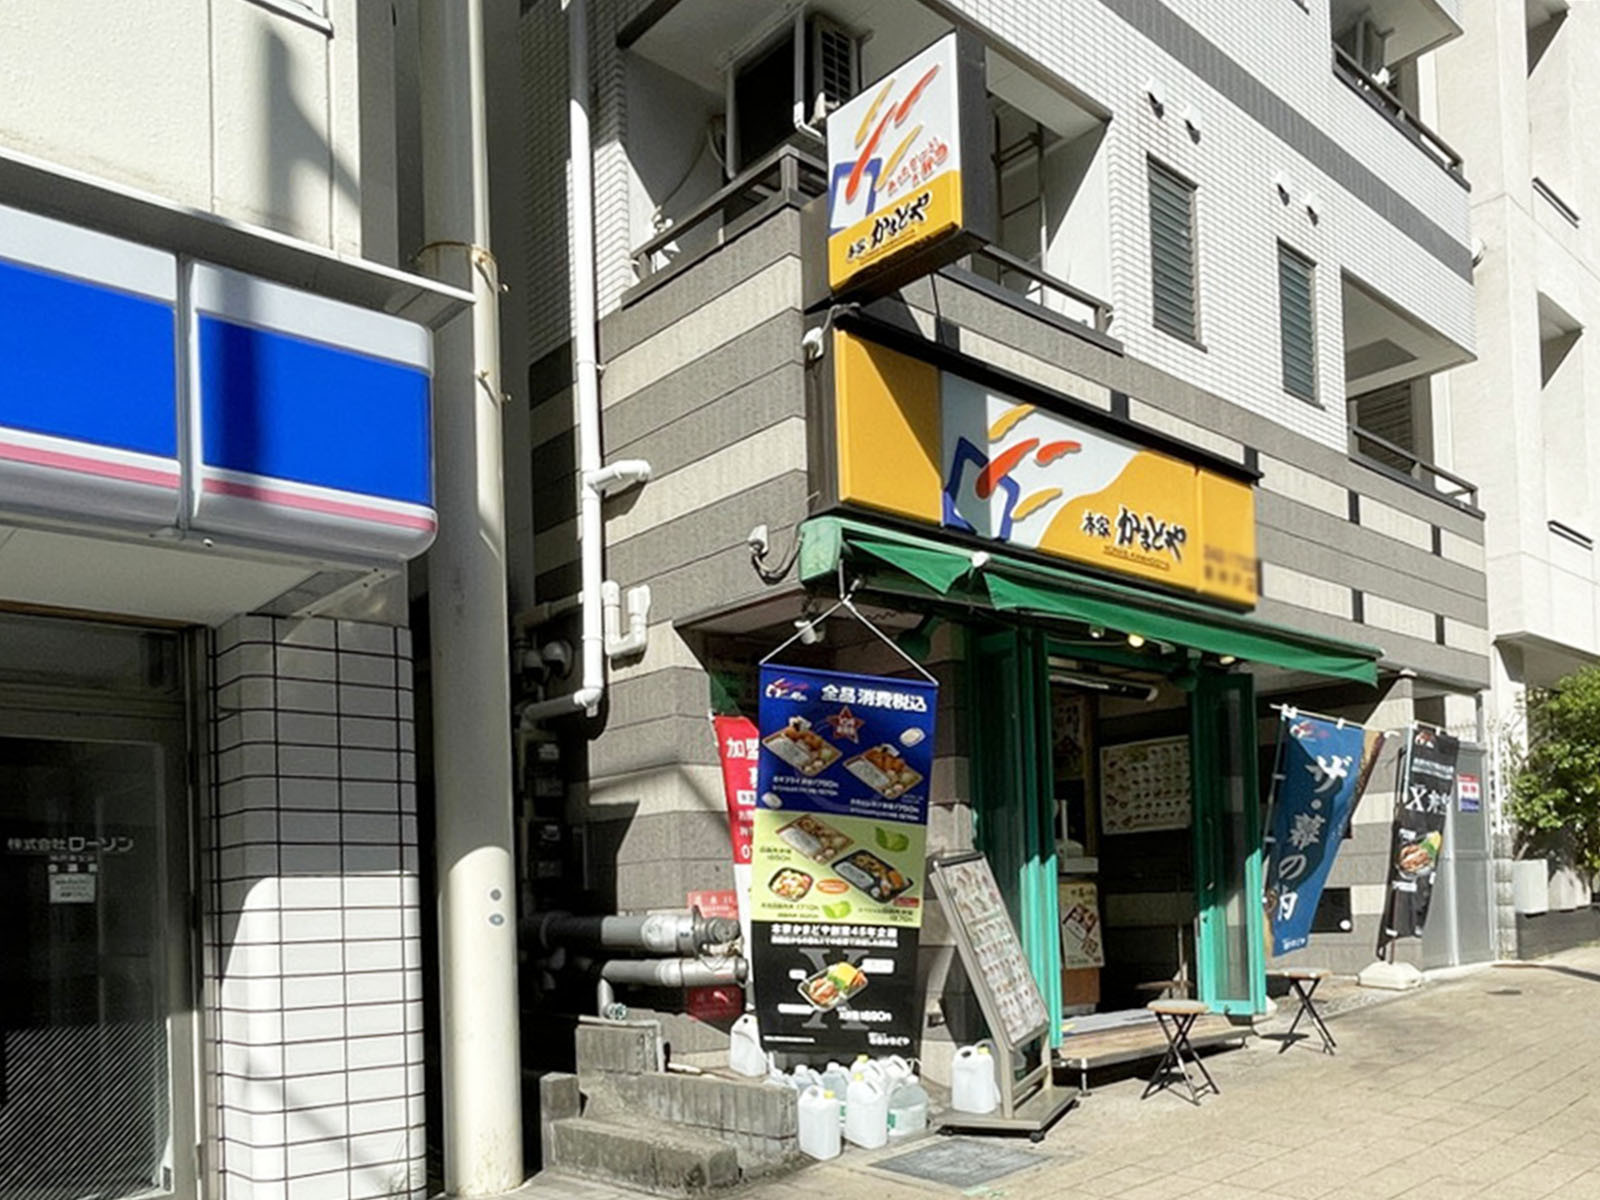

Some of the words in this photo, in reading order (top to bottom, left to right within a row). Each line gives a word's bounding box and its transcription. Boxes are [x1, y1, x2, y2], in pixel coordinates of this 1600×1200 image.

[1117, 505, 1187, 563] かまどや
[7, 837, 134, 852] 株式会社ローソン
